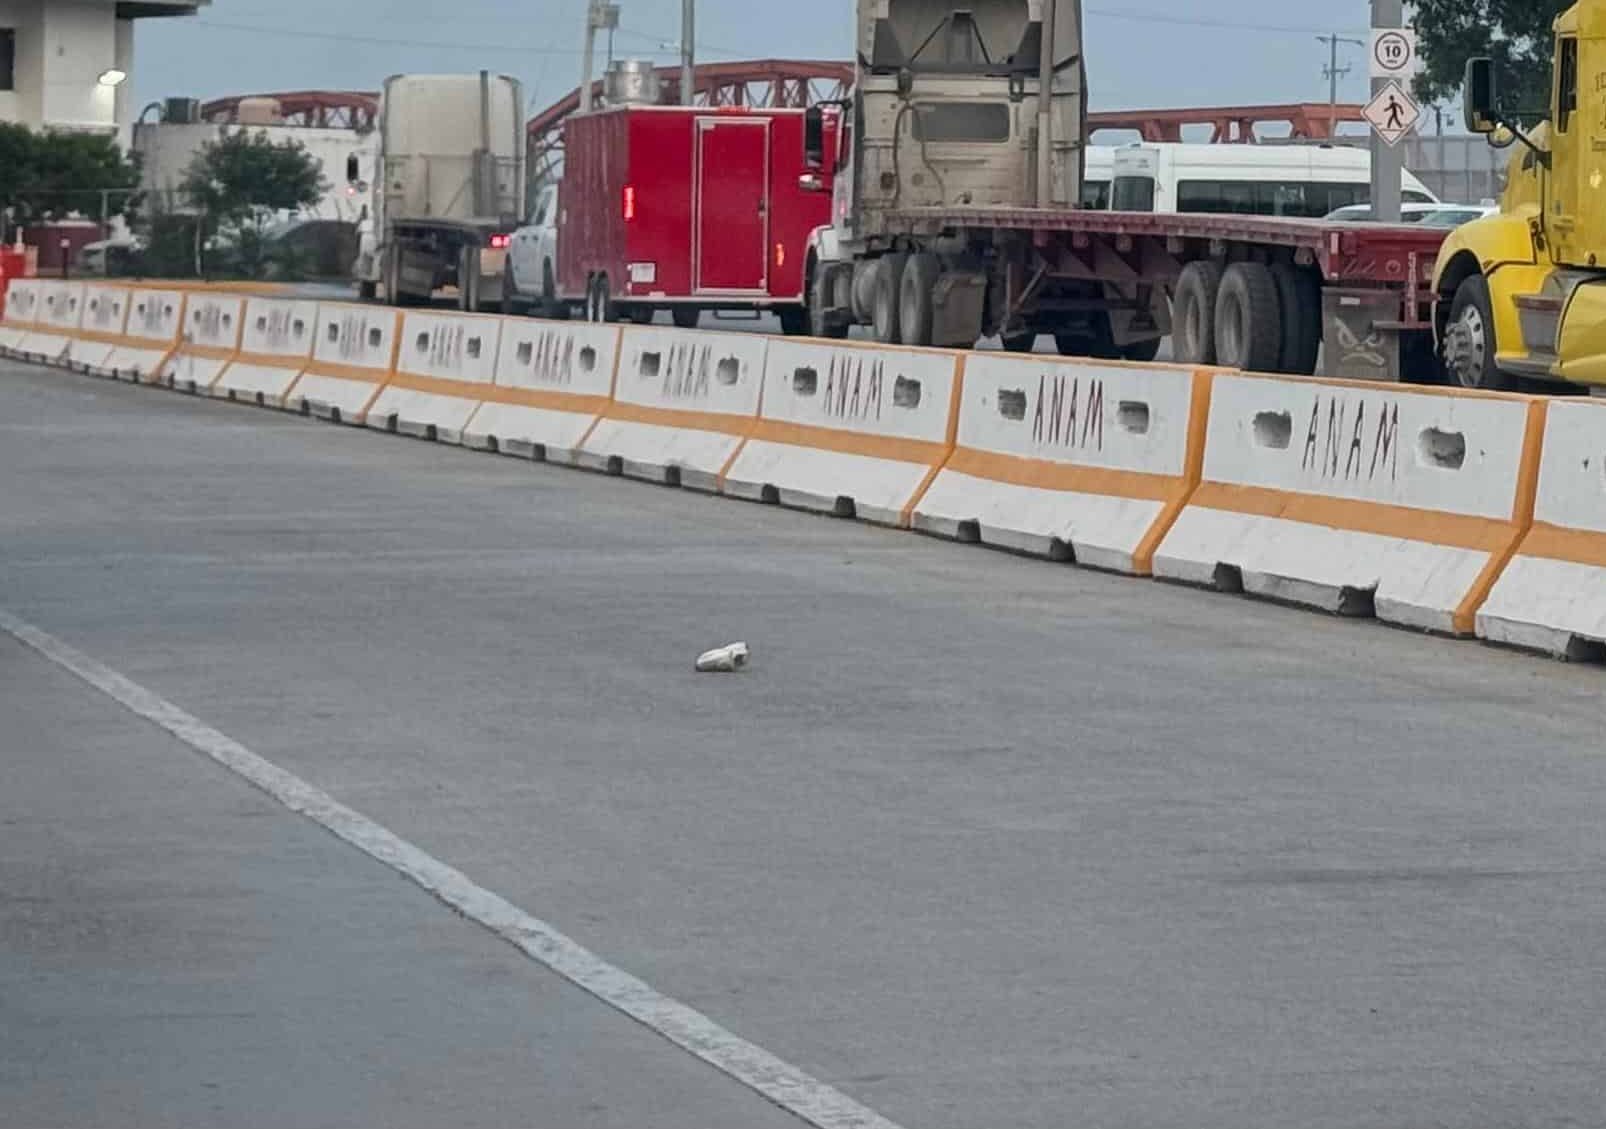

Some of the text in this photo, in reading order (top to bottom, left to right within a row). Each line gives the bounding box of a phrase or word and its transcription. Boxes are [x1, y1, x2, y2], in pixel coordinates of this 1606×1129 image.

[1385, 45, 1401, 57] 10
[823, 352, 884, 421] ANAM
[1032, 374, 1103, 451] ANAM
[1302, 394, 1398, 482] ANAM
